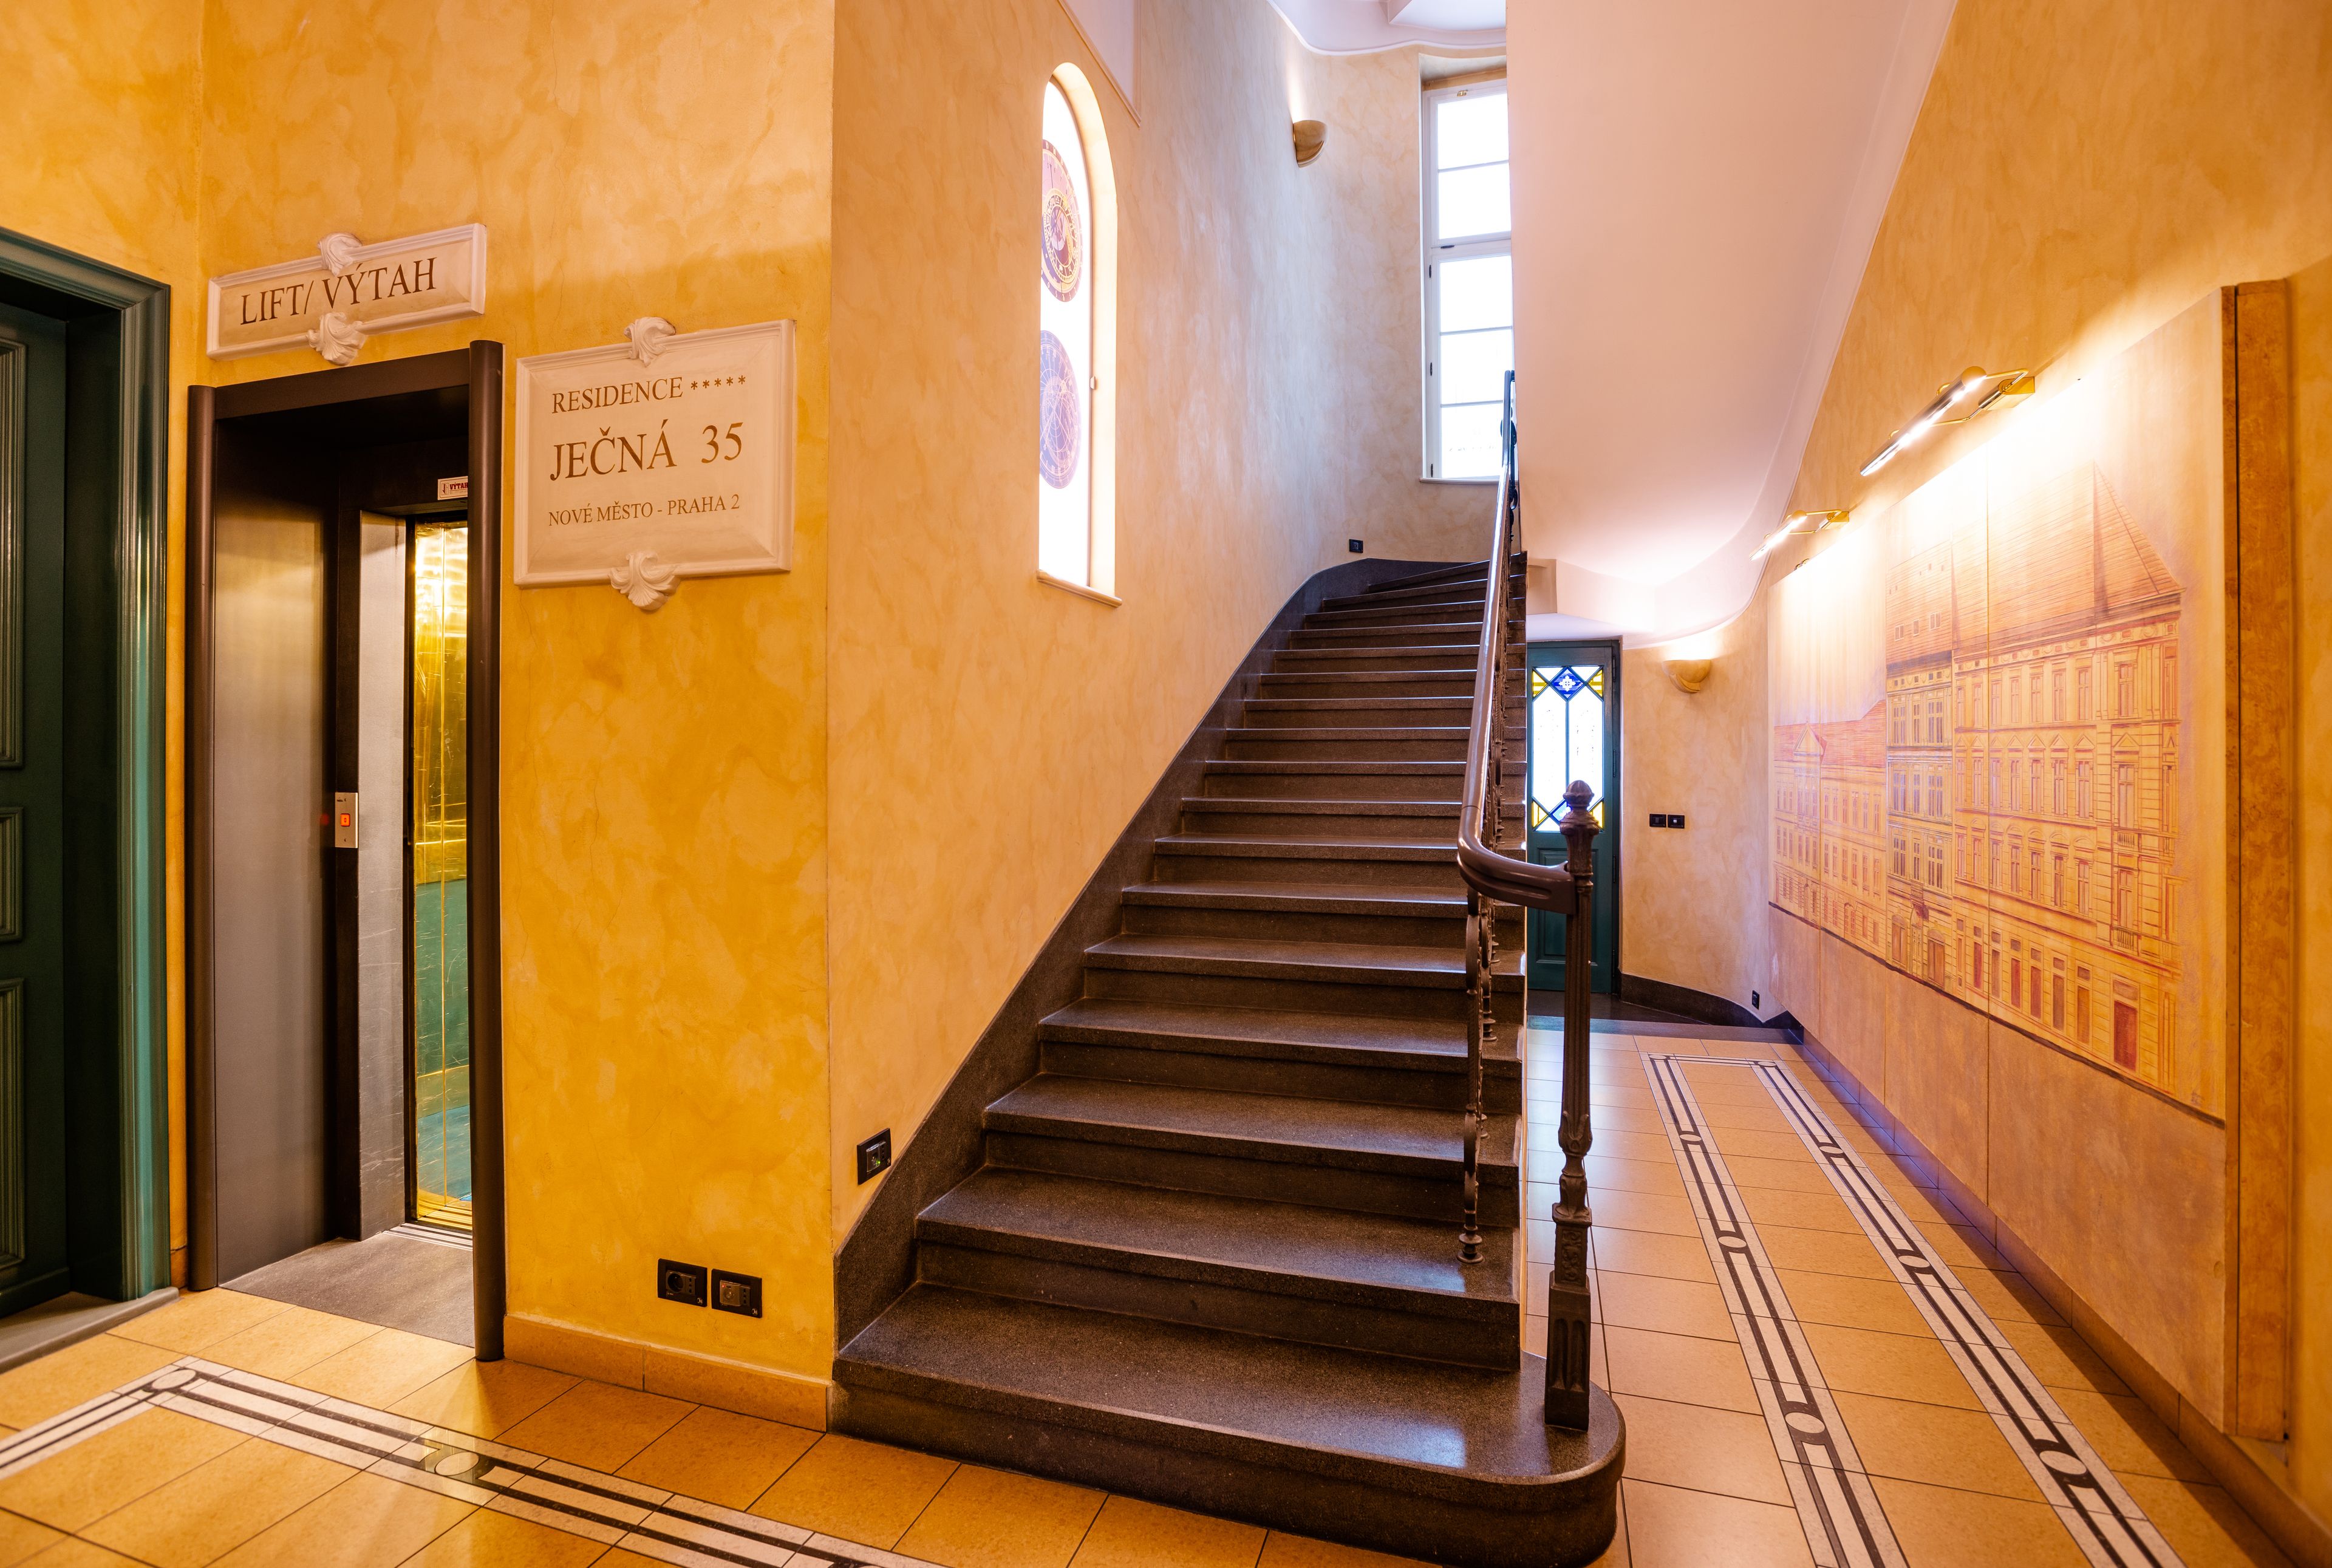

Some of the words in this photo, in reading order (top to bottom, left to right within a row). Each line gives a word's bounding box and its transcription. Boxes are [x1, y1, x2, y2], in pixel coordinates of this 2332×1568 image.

[240, 280, 315, 326] LIFT/
[321, 257, 437, 309] VÝTAH
[551, 377, 683, 414] RESIDENCE
[550, 418, 677, 482] JEČNÁ
[701, 422, 743, 464] 35
[548, 503, 593, 527] NOVÉ
[597, 500, 653, 522] MĚSTO
[667, 495, 726, 516] PRAHA
[731, 494, 740, 510] 2
